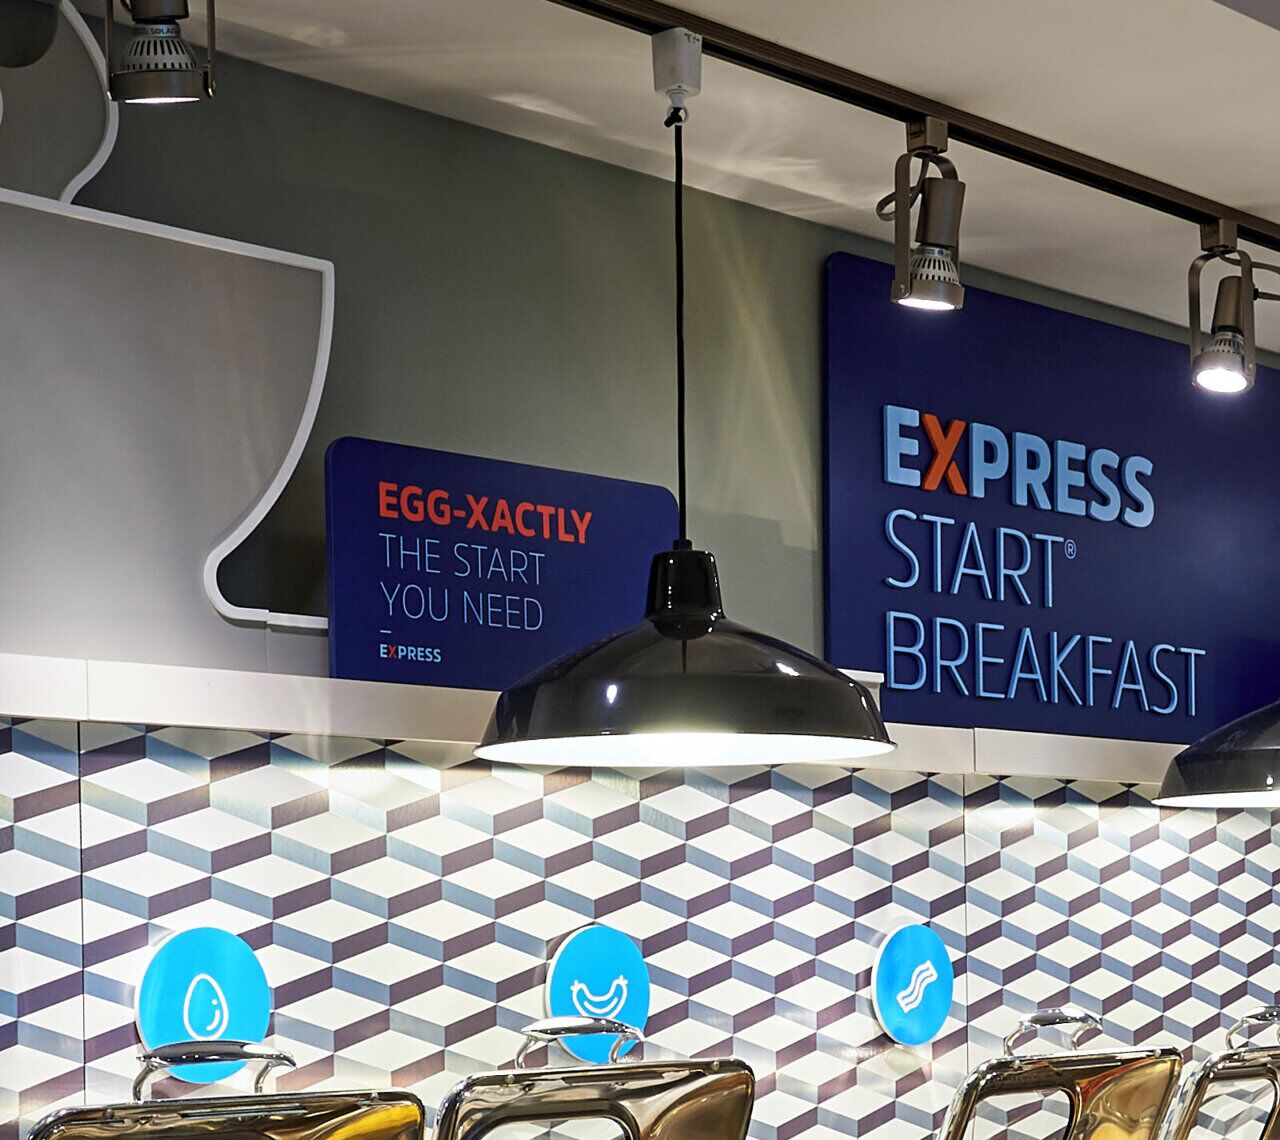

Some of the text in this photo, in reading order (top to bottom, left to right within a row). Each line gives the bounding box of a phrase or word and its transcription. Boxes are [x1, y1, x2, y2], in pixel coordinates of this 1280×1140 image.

[882, 404, 1156, 529] EXPRESS
[377, 480, 593, 544] EGG-XACTLY
[378, 532, 546, 585] THE START
[379, 580, 544, 631] YOU NEED
[379, 643, 442, 663] EXPRESS
[885, 610, 1207, 717] BREAKFAST
